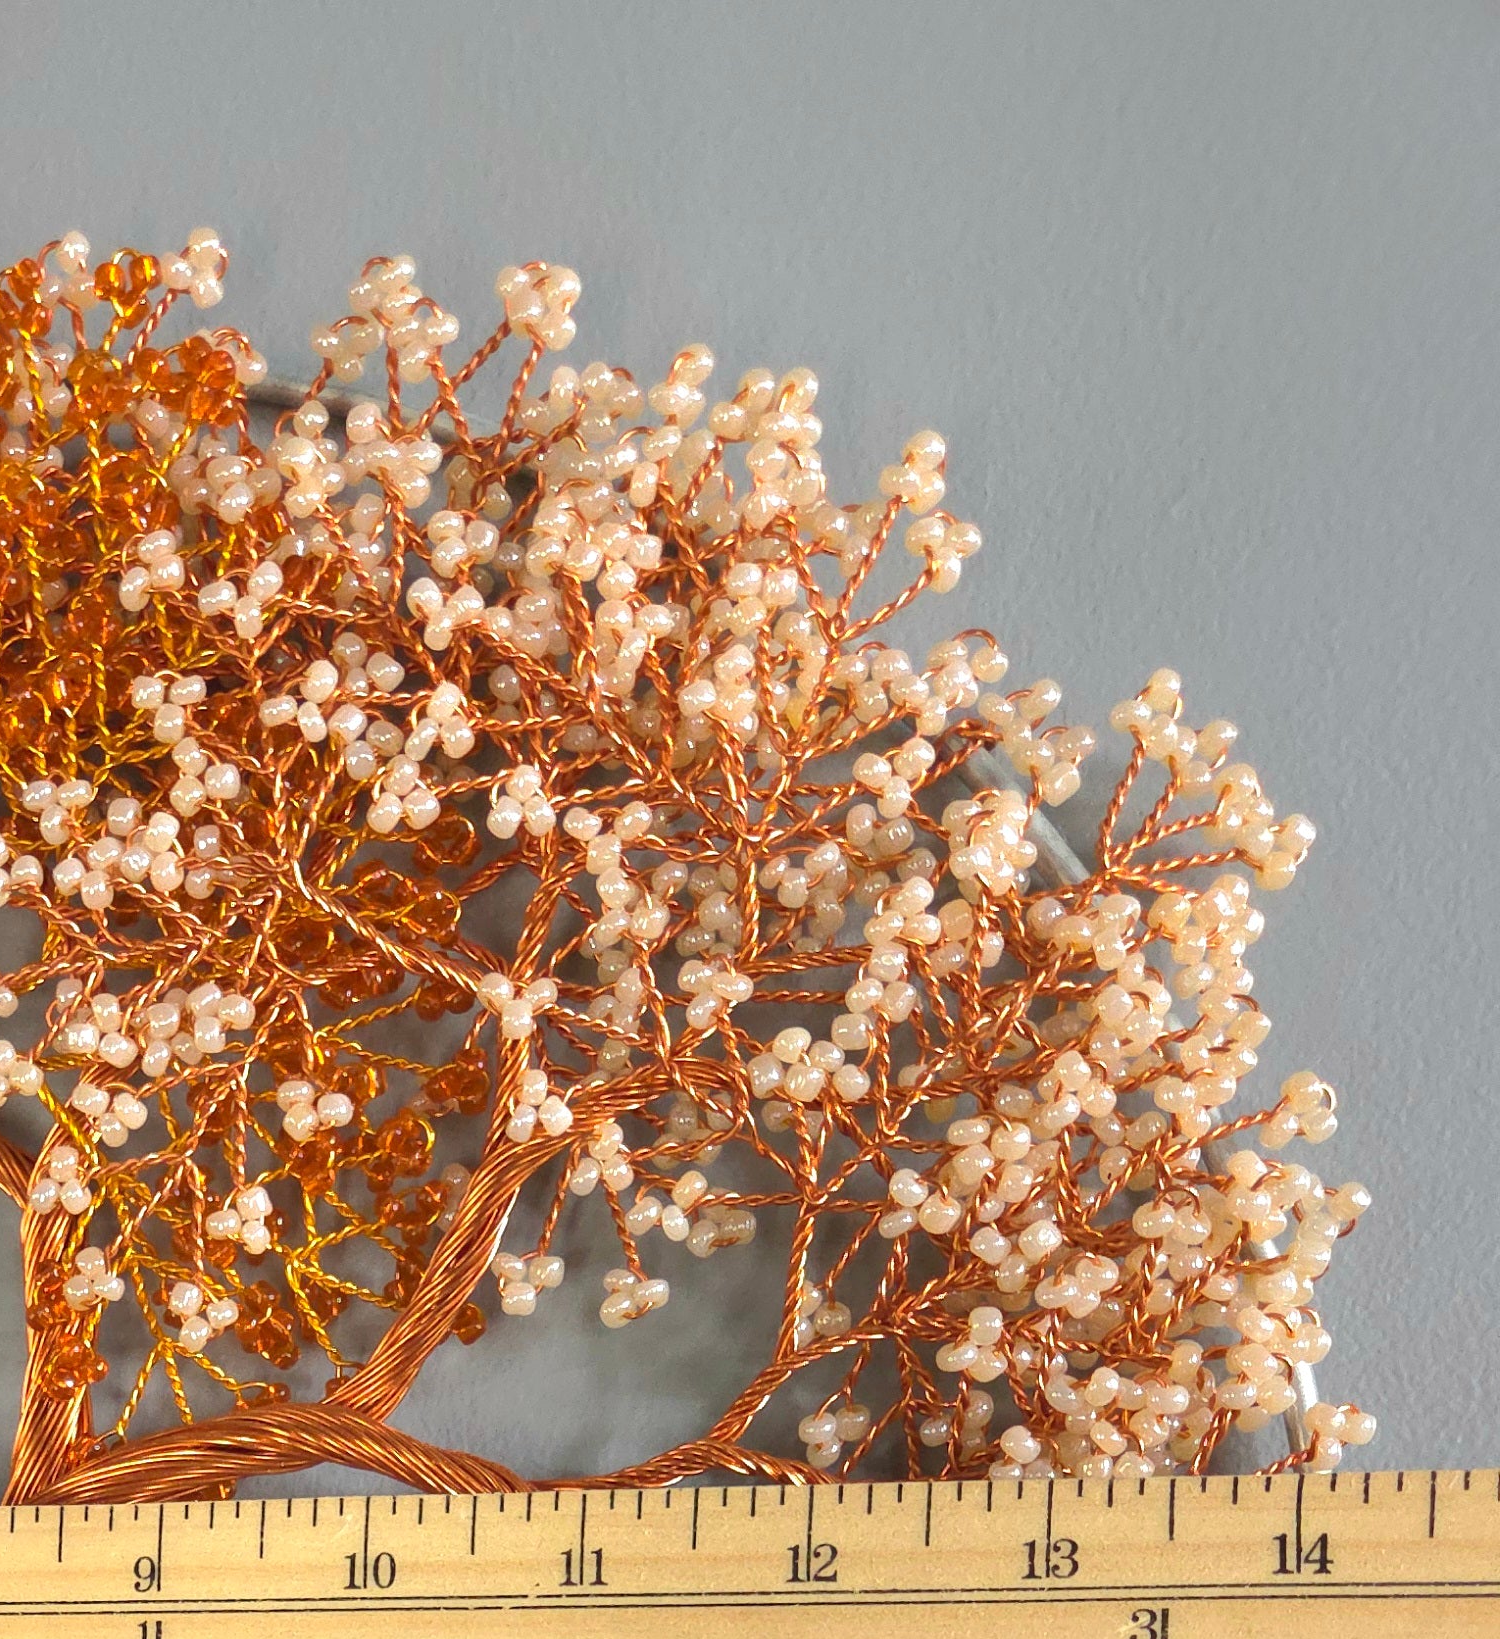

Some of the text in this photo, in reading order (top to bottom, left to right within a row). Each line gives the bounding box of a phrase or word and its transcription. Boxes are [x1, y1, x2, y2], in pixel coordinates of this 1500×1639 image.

[134, 1556, 155, 1592] 9
[342, 1553, 396, 1590] 10
[560, 1550, 606, 1586] 11
[786, 1545, 838, 1582] 12
[1022, 1539, 1079, 1578] 13
[1272, 1534, 1334, 1574] 14
